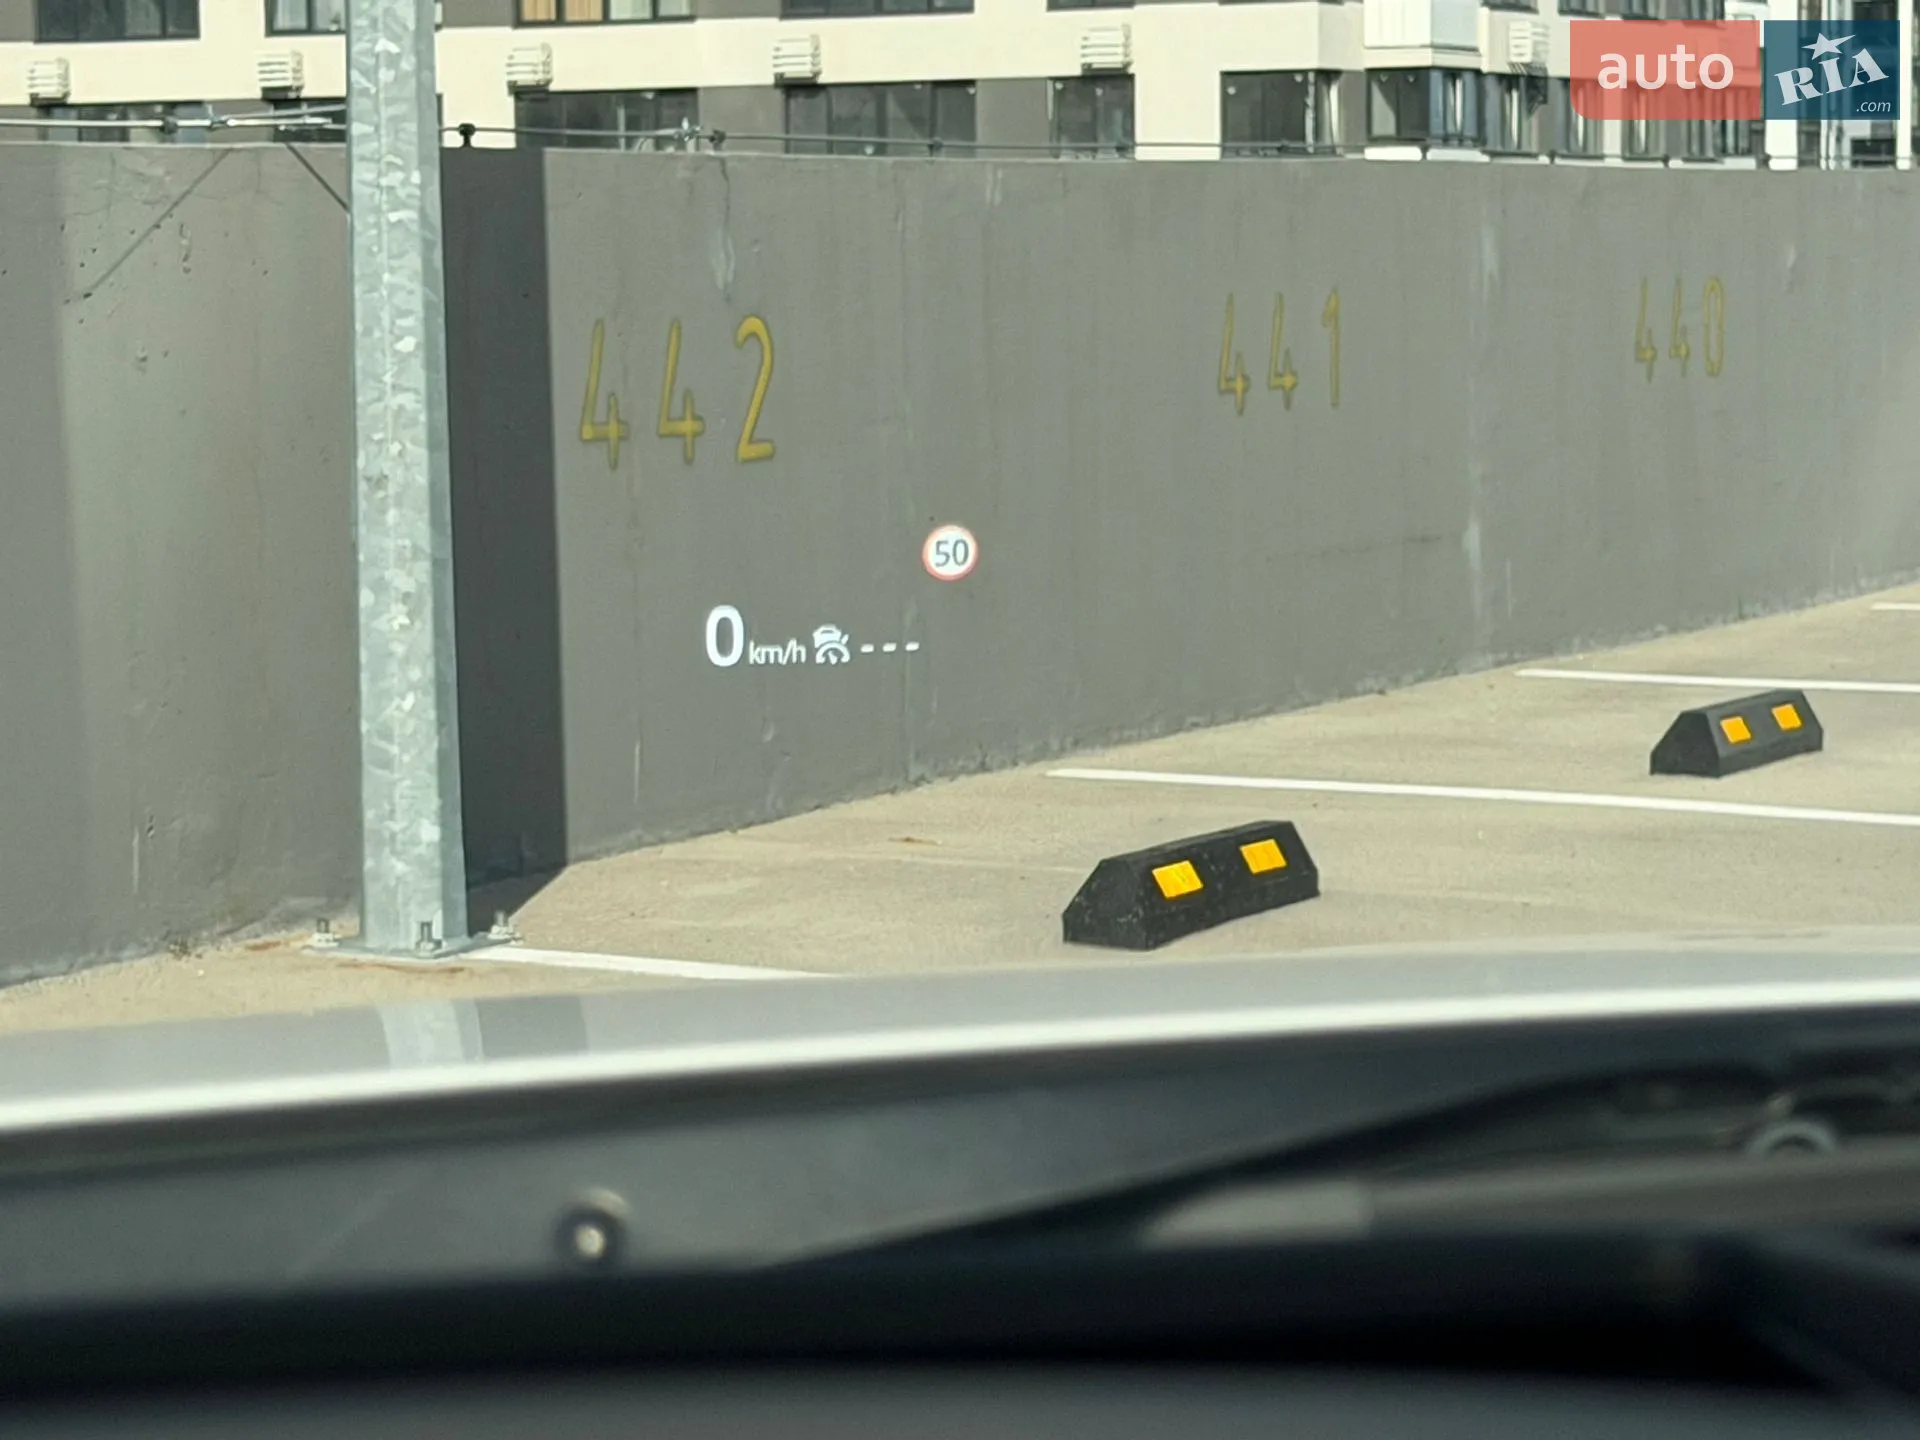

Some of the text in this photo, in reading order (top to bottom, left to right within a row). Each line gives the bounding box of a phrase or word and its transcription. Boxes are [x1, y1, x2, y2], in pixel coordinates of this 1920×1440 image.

[1217, 287, 1341, 416] 441
[1634, 275, 1725, 384] 440
[580, 315, 776, 470] 442
[934, 539, 970, 567] 50
[705, 604, 807, 667] 0 km/h
